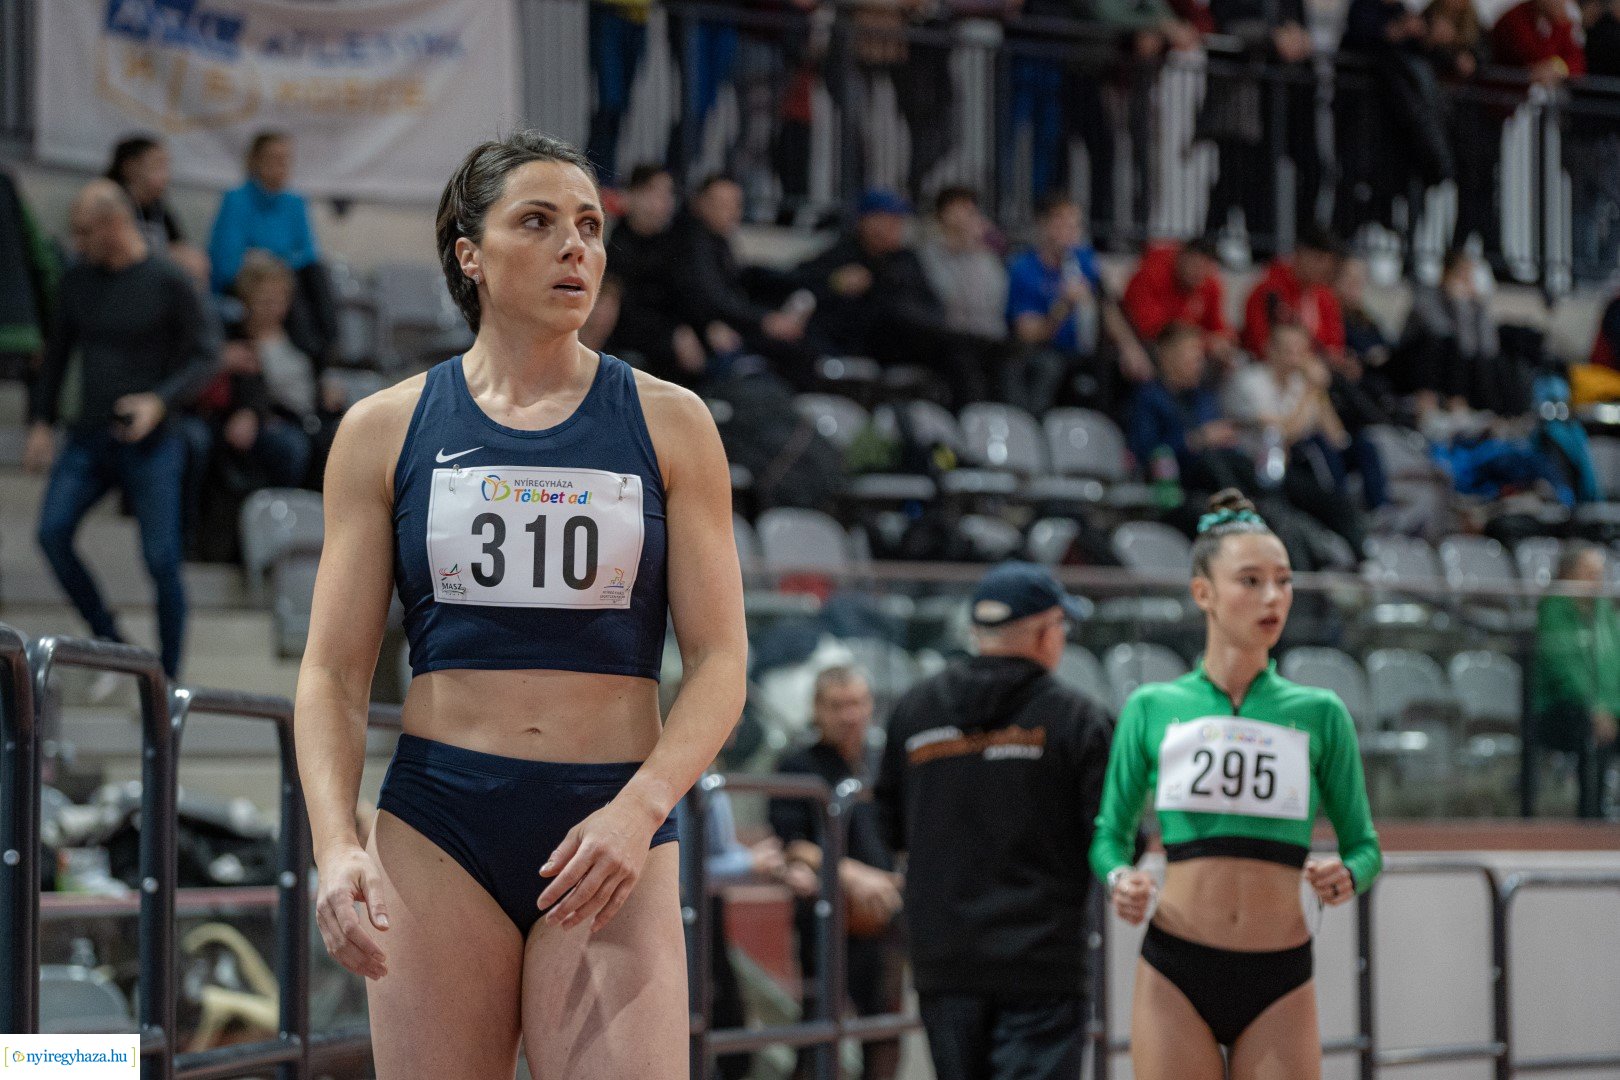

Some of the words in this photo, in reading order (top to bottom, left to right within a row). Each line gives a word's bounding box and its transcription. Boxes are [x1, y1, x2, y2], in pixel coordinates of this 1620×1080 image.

[514, 478, 573, 488] NYÍREGYHÁZA
[514, 488, 565, 503] Többet
[568, 490, 593, 505] ad!
[471, 512, 599, 590] 310
[441, 582, 463, 590] MASZ
[1190, 749, 1276, 800] 295
